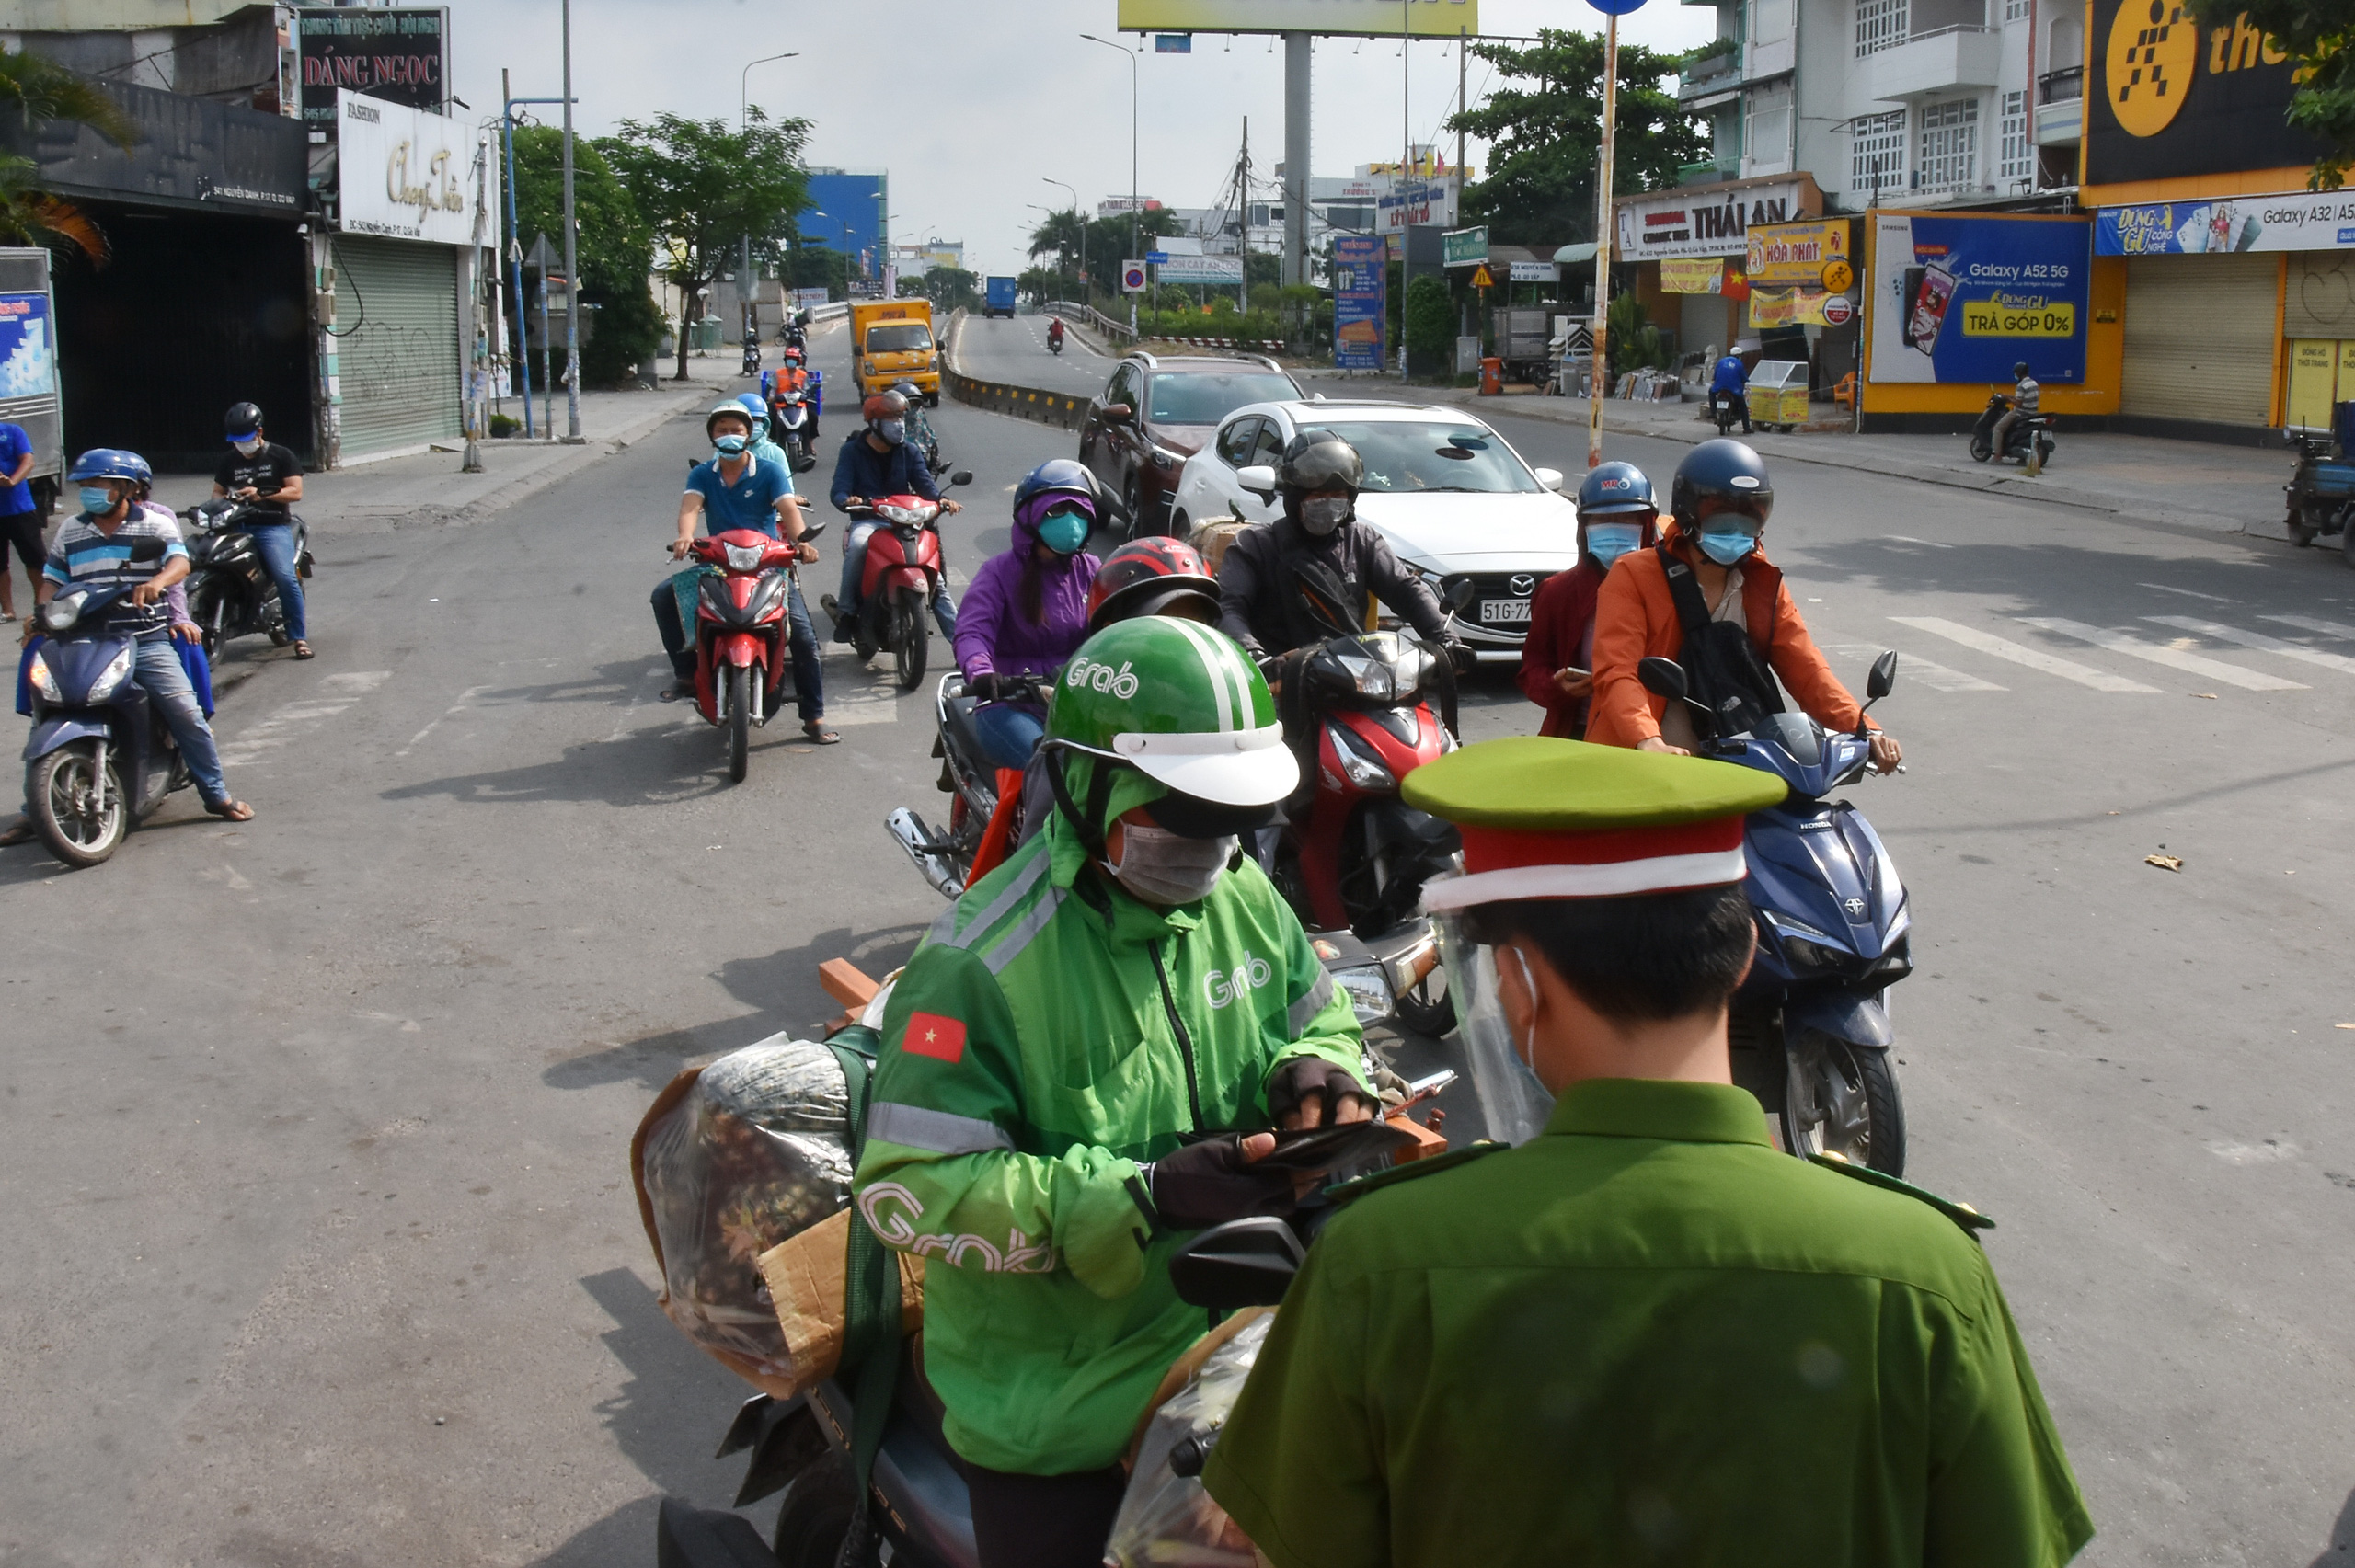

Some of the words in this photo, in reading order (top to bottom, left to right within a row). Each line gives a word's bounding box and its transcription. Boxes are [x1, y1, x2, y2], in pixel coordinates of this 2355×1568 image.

[373, 54, 438, 93] NGỌC
[347, 102, 381, 125] FASHION
[1692, 193, 1746, 239] THÁI
[1752, 198, 1786, 223] AN
[2118, 208, 2154, 228] ĐÚNG
[2263, 208, 2307, 228] Galaxy
[2308, 206, 2332, 222] A32
[2338, 203, 2355, 221] A5
[2151, 229, 2173, 241] CÔNG
[2148, 240, 2166, 253] NGHỆ
[1970, 263, 2020, 281] Galaxy
[2023, 264, 2047, 278] A52
[2051, 264, 2069, 278] 5G
[1969, 311, 1999, 331] TRẢ
[2004, 310, 2039, 331] GÓP
[2043, 313, 2069, 332] 0%
[1483, 603, 1532, 620] 51G-77
[1066, 657, 1139, 700] Grab
[1799, 820, 1832, 829] HONDA
